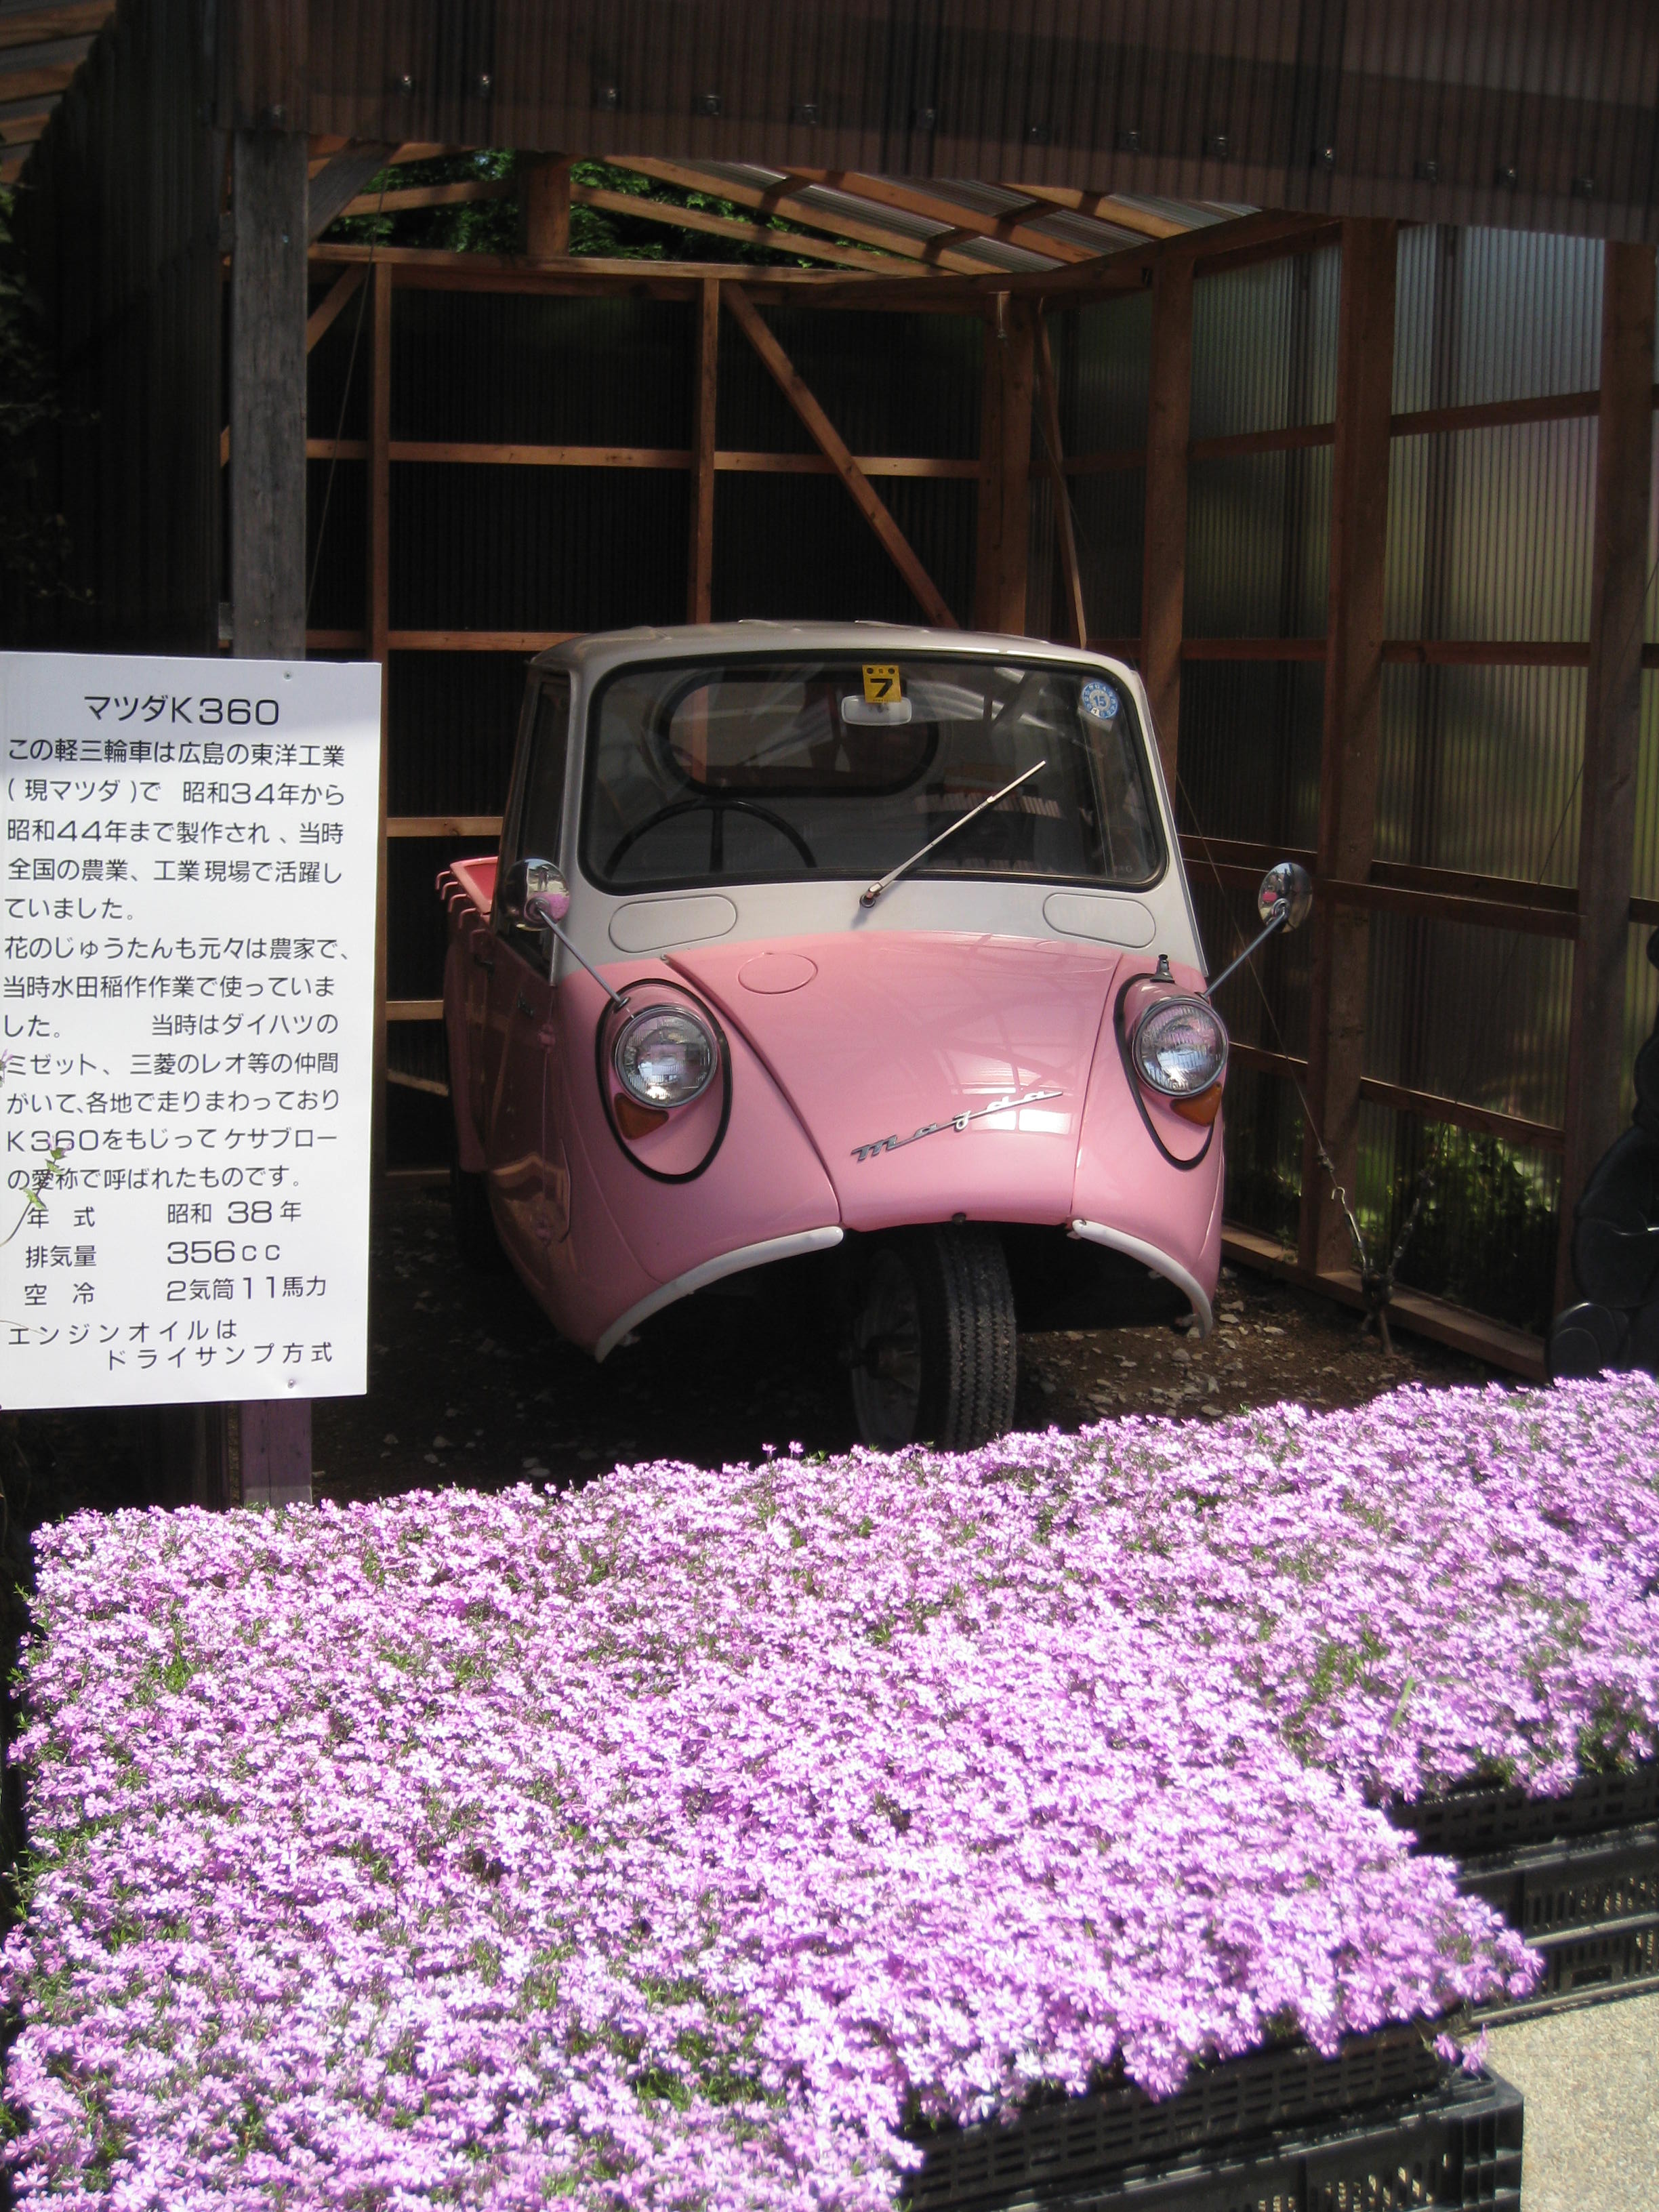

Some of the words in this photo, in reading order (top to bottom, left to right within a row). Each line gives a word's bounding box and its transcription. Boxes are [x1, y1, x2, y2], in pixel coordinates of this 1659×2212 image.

[870, 678, 893, 697] 7
[84, 695, 279, 726] マツダK360
[9, 738, 345, 768] この軽三輪車は広島の東洋工業
[183, 781, 344, 805] 昭和34年から
[8, 819, 344, 844] 昭和44年まで製作され、当時
[8, 857, 342, 884] 全国の農業、工業現場で活躍し
[5, 897, 132, 920] ていました。
[5, 936, 347, 960] 花のじゅうたんも元々は農家で、
[3, 975, 334, 999] 当時水田稲作作業で使っていま
[5, 1015, 60, 1038] した。
[152, 1013, 338, 1036] 当時はダイハツの
[7, 1090, 338, 1114] がいて、各地で走りまわっており
[7, 1126, 337, 1152] K360をもじってケサブロー
[7, 1164, 301, 1191] の愛称で呼ばれたものです。
[26, 1245, 97, 1269] 排気量
[167, 1240, 280, 1264] 356cc
[167, 1275, 326, 1301] 2気筒11馬力
[8, 1319, 237, 1345] エンジンオイルは
[108, 1341, 332, 1370] ドライサンプ方式
